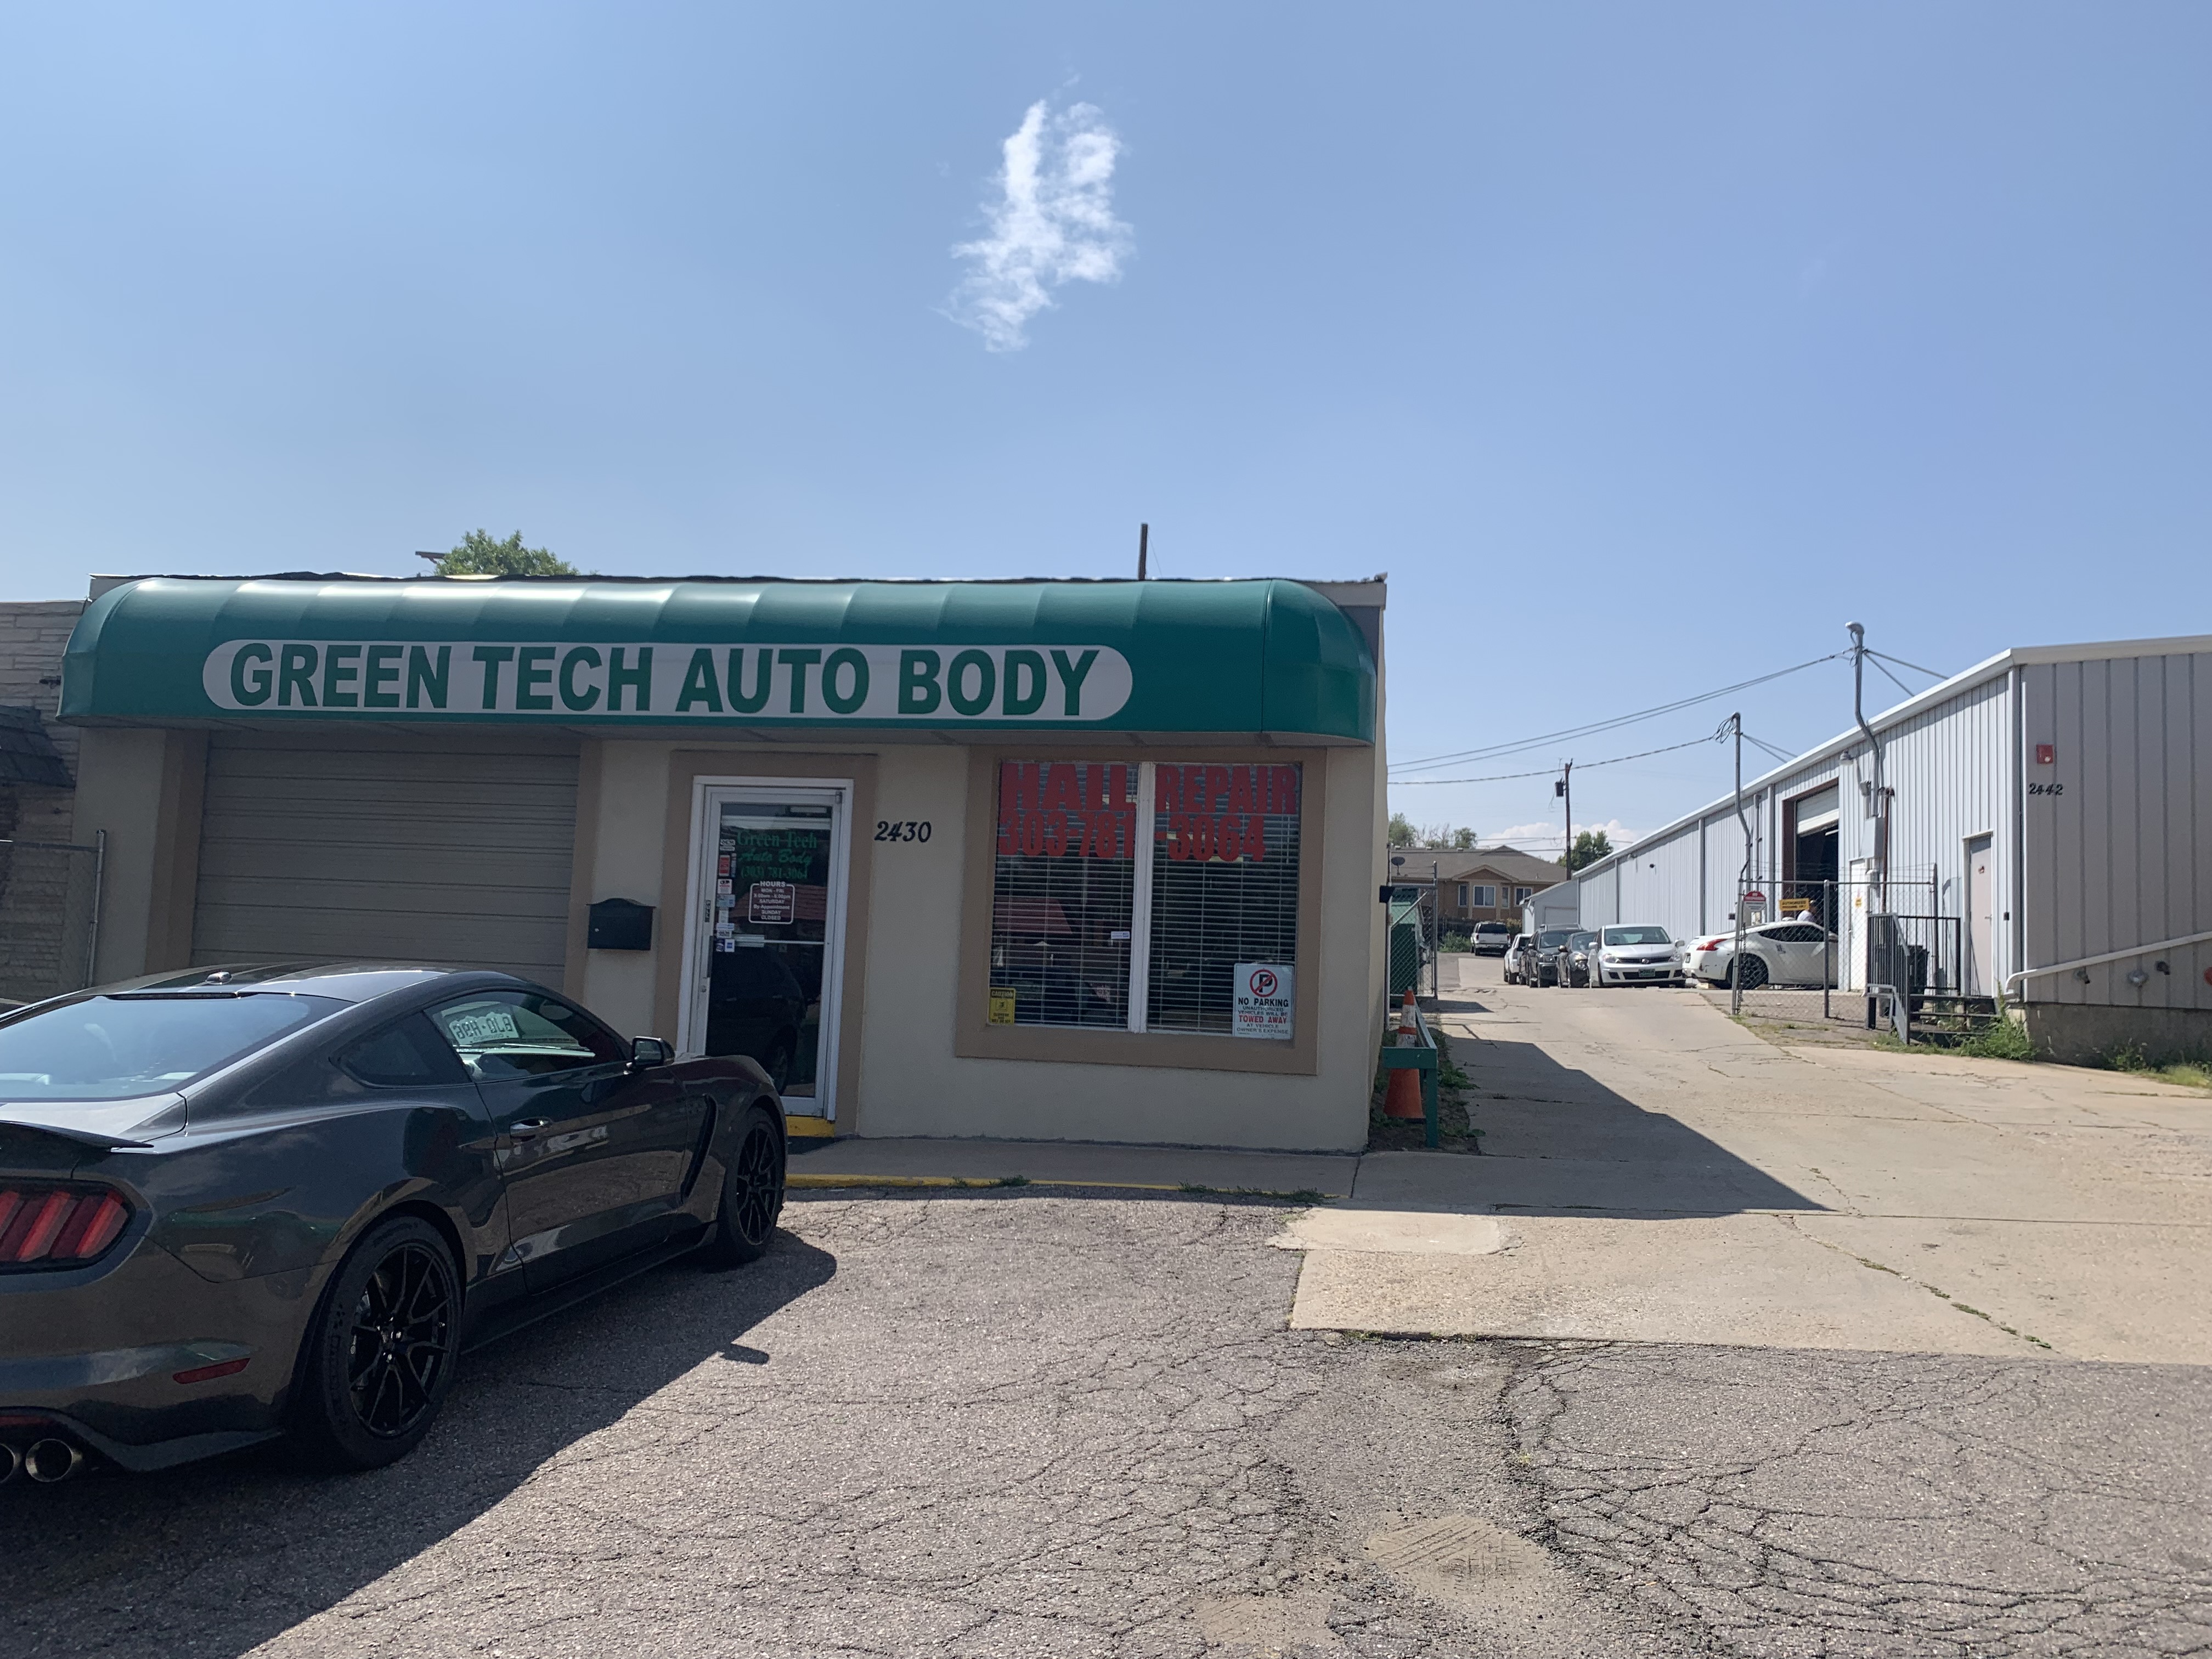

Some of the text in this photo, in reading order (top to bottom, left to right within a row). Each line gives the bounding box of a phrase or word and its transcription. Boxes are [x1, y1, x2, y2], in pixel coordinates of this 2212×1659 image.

[230, 643, 1101, 716] GREEN TECH AUTO BODY
[1001, 763, 1297, 814] HAIL REPAIR
[2029, 782, 2063, 795] 2442
[737, 829, 817, 848] Green Tech
[874, 821, 932, 843] 2430
[778, 849, 812, 867] Body
[1238, 997, 1289, 1007] NO PARKING
[1239, 1015, 1263, 1023] TOWED
